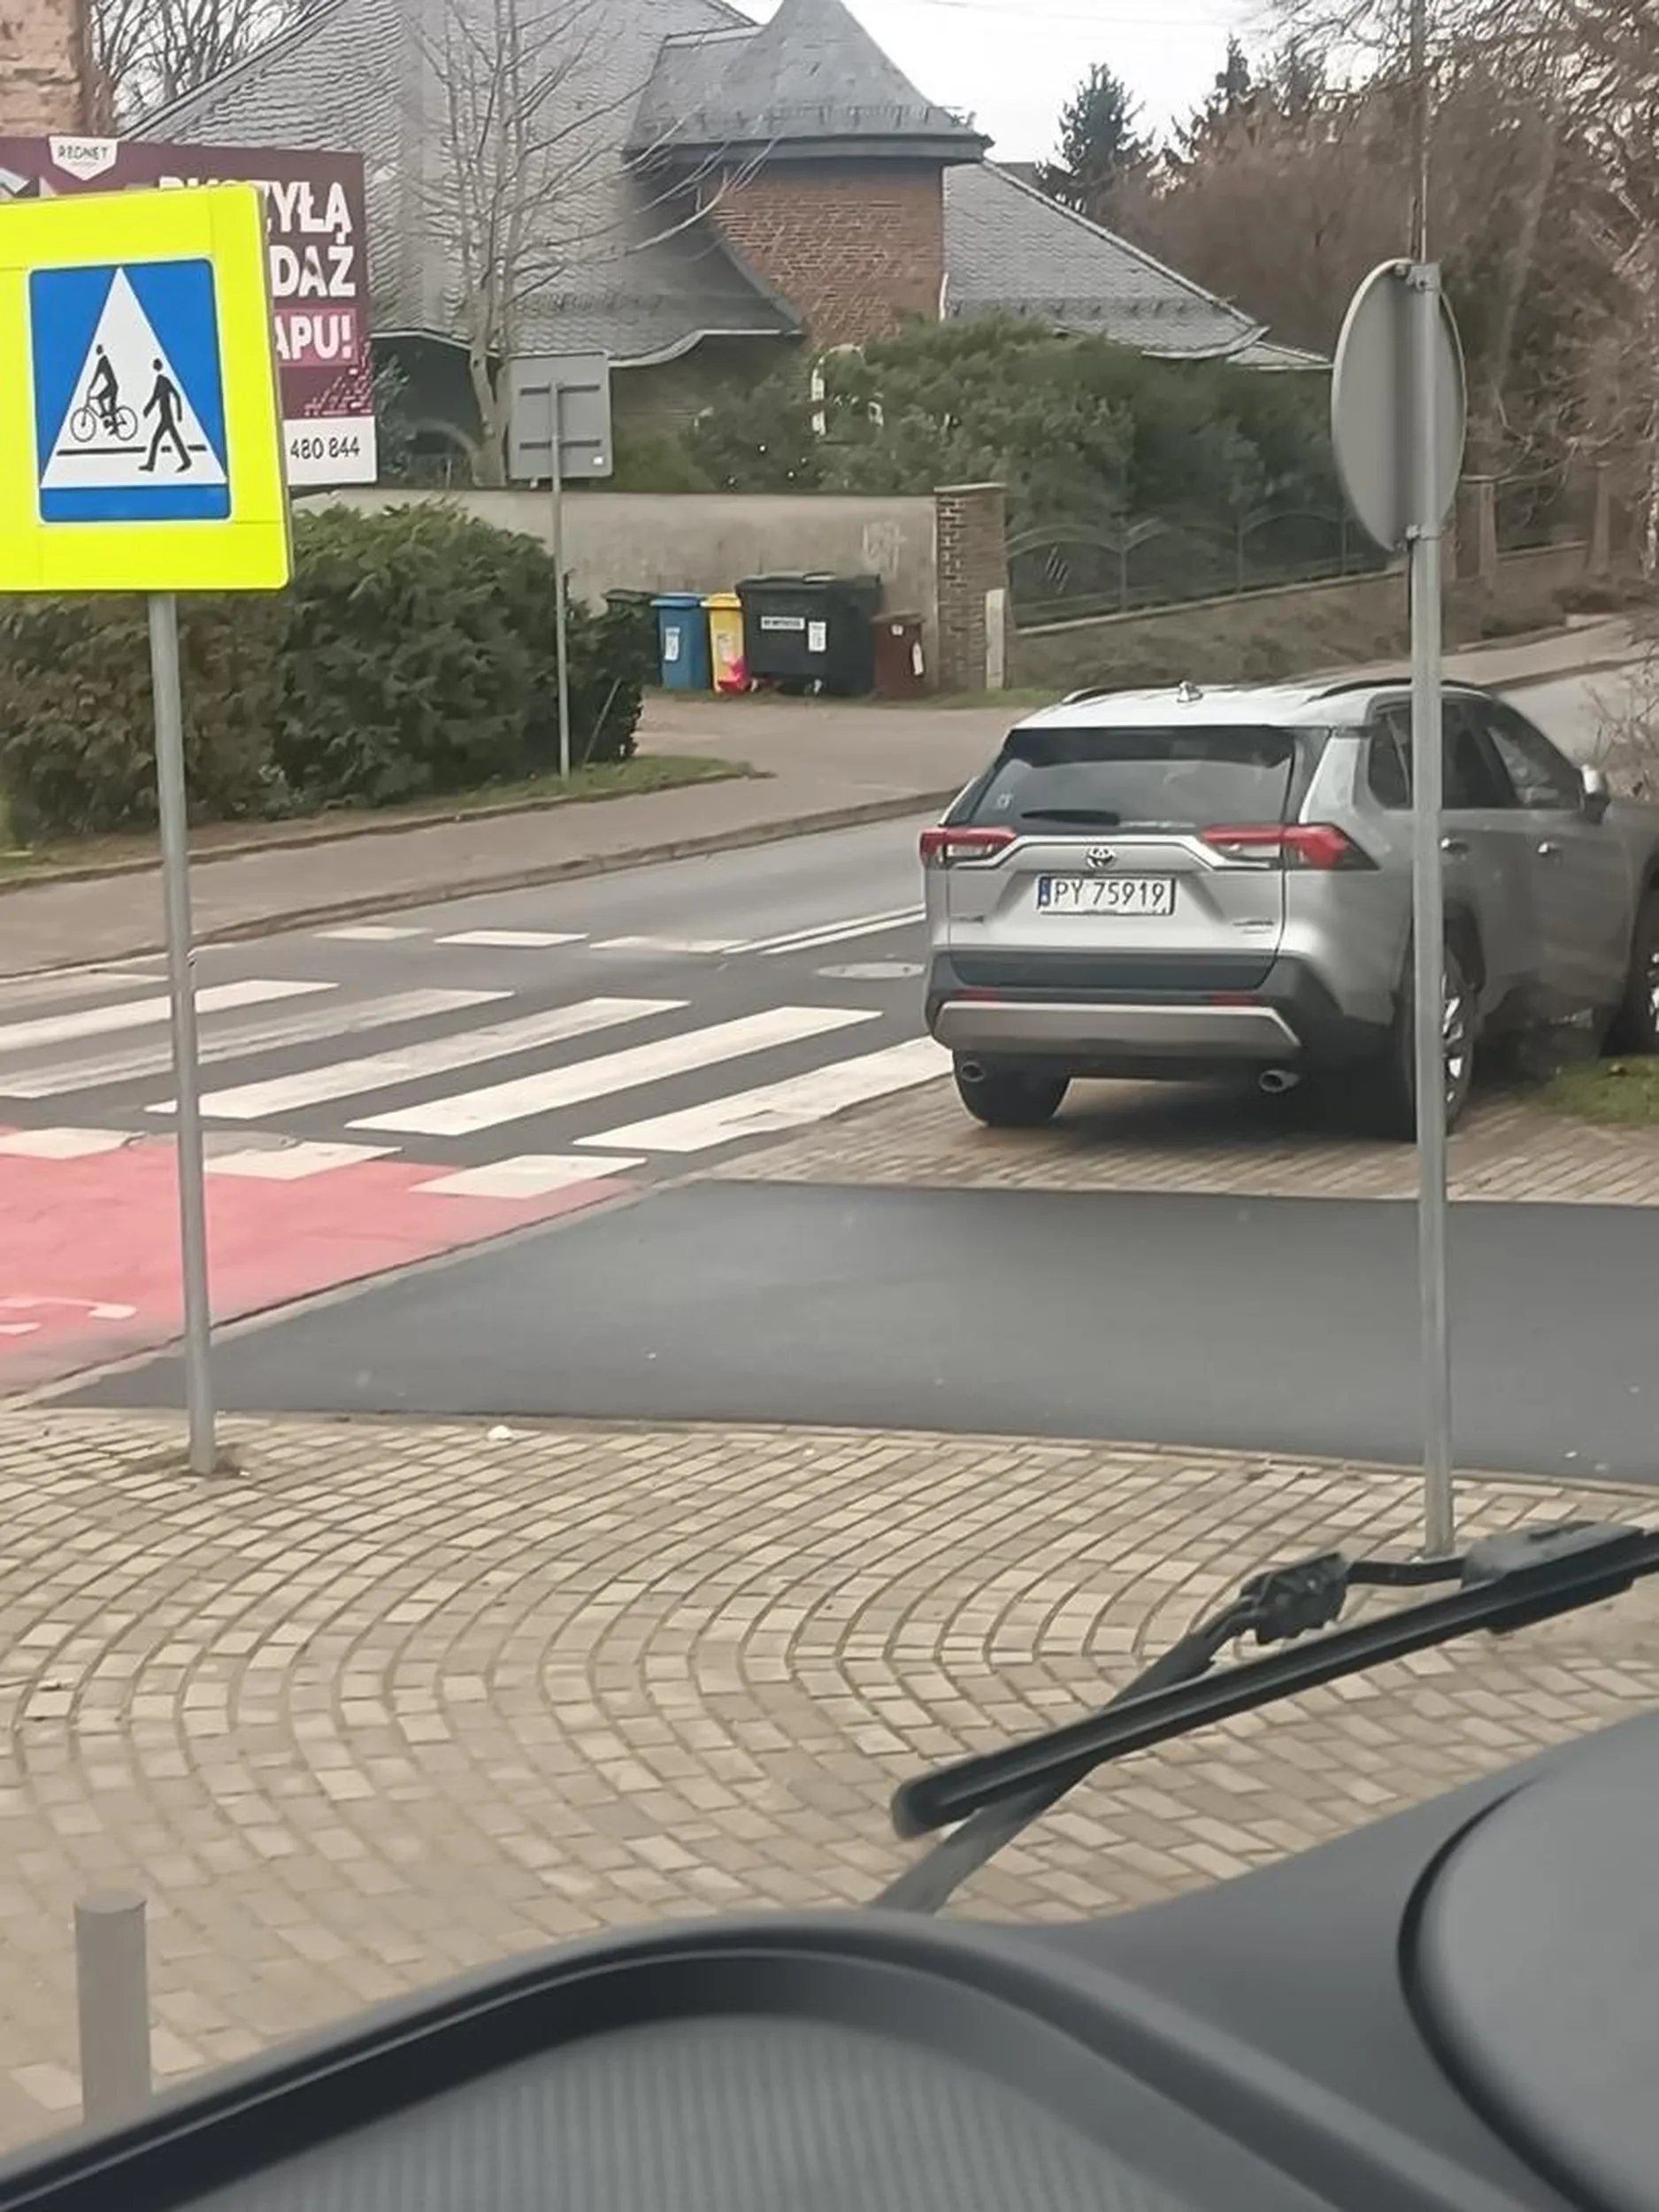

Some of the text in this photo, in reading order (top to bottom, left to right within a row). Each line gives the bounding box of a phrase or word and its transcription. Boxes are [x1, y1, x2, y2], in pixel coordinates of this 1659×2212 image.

[274, 315, 352, 360] APU!
[290, 436, 360, 459] 480 844
[1055, 881, 1165, 907] PY 75919
